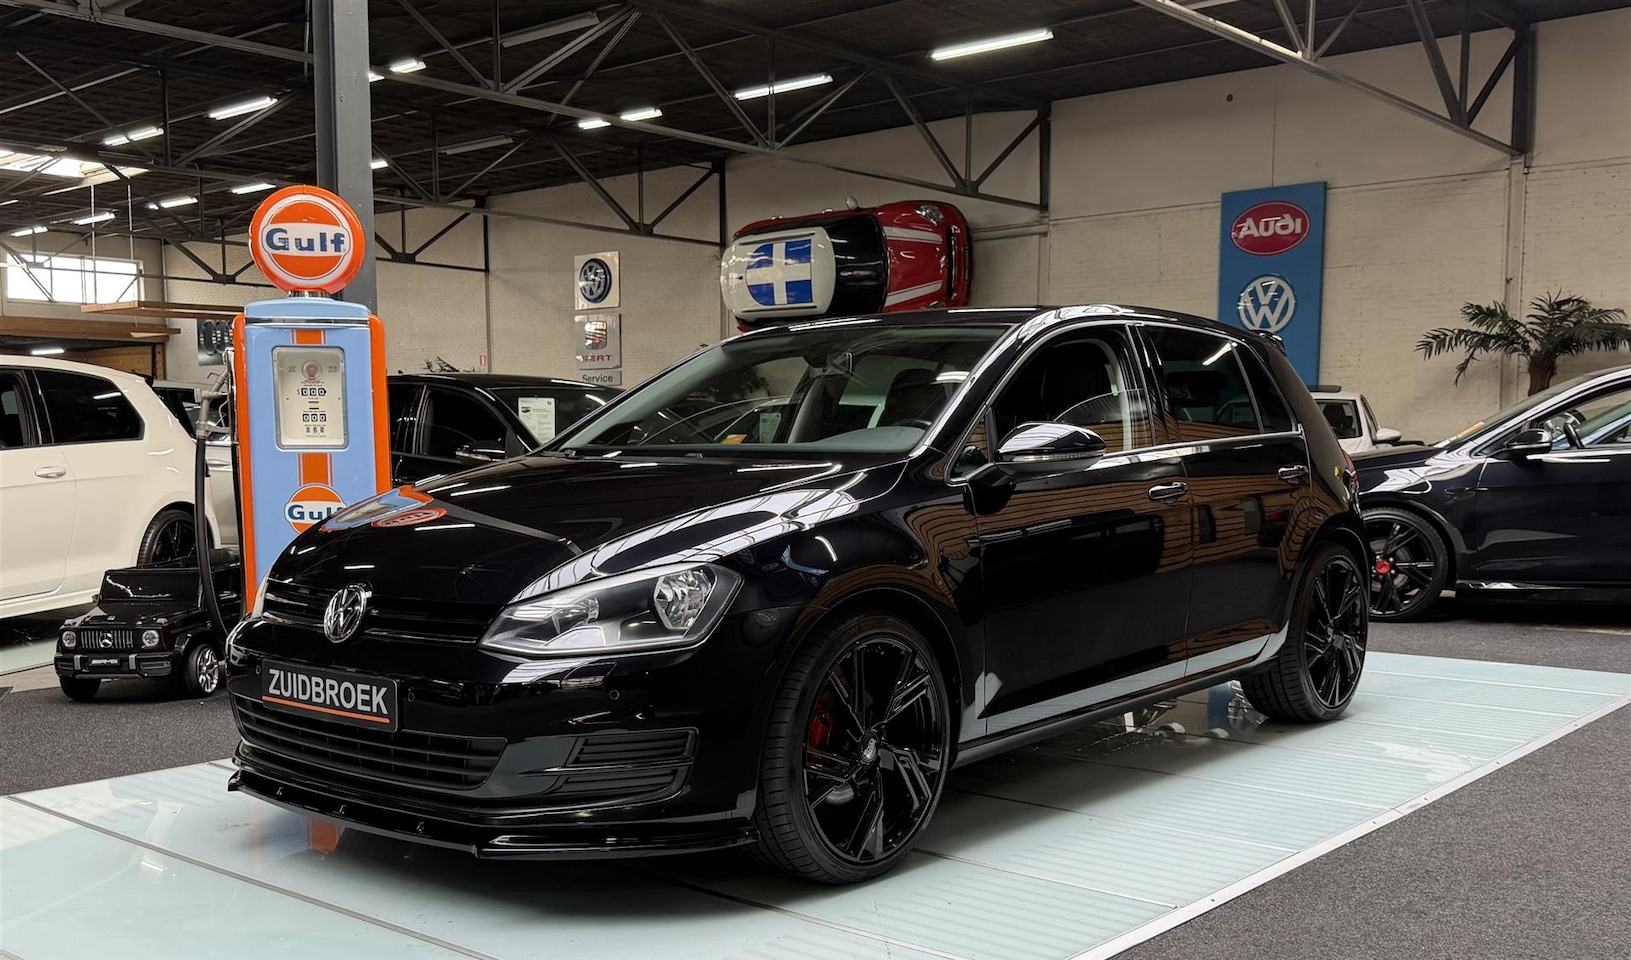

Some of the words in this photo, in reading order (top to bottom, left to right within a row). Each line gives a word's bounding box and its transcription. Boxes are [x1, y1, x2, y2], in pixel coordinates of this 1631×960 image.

[266, 228, 345, 253] Gulf
[582, 374, 614, 383] Service
[288, 504, 344, 520] Gul
[268, 668, 389, 715] ZUIDBROEK
